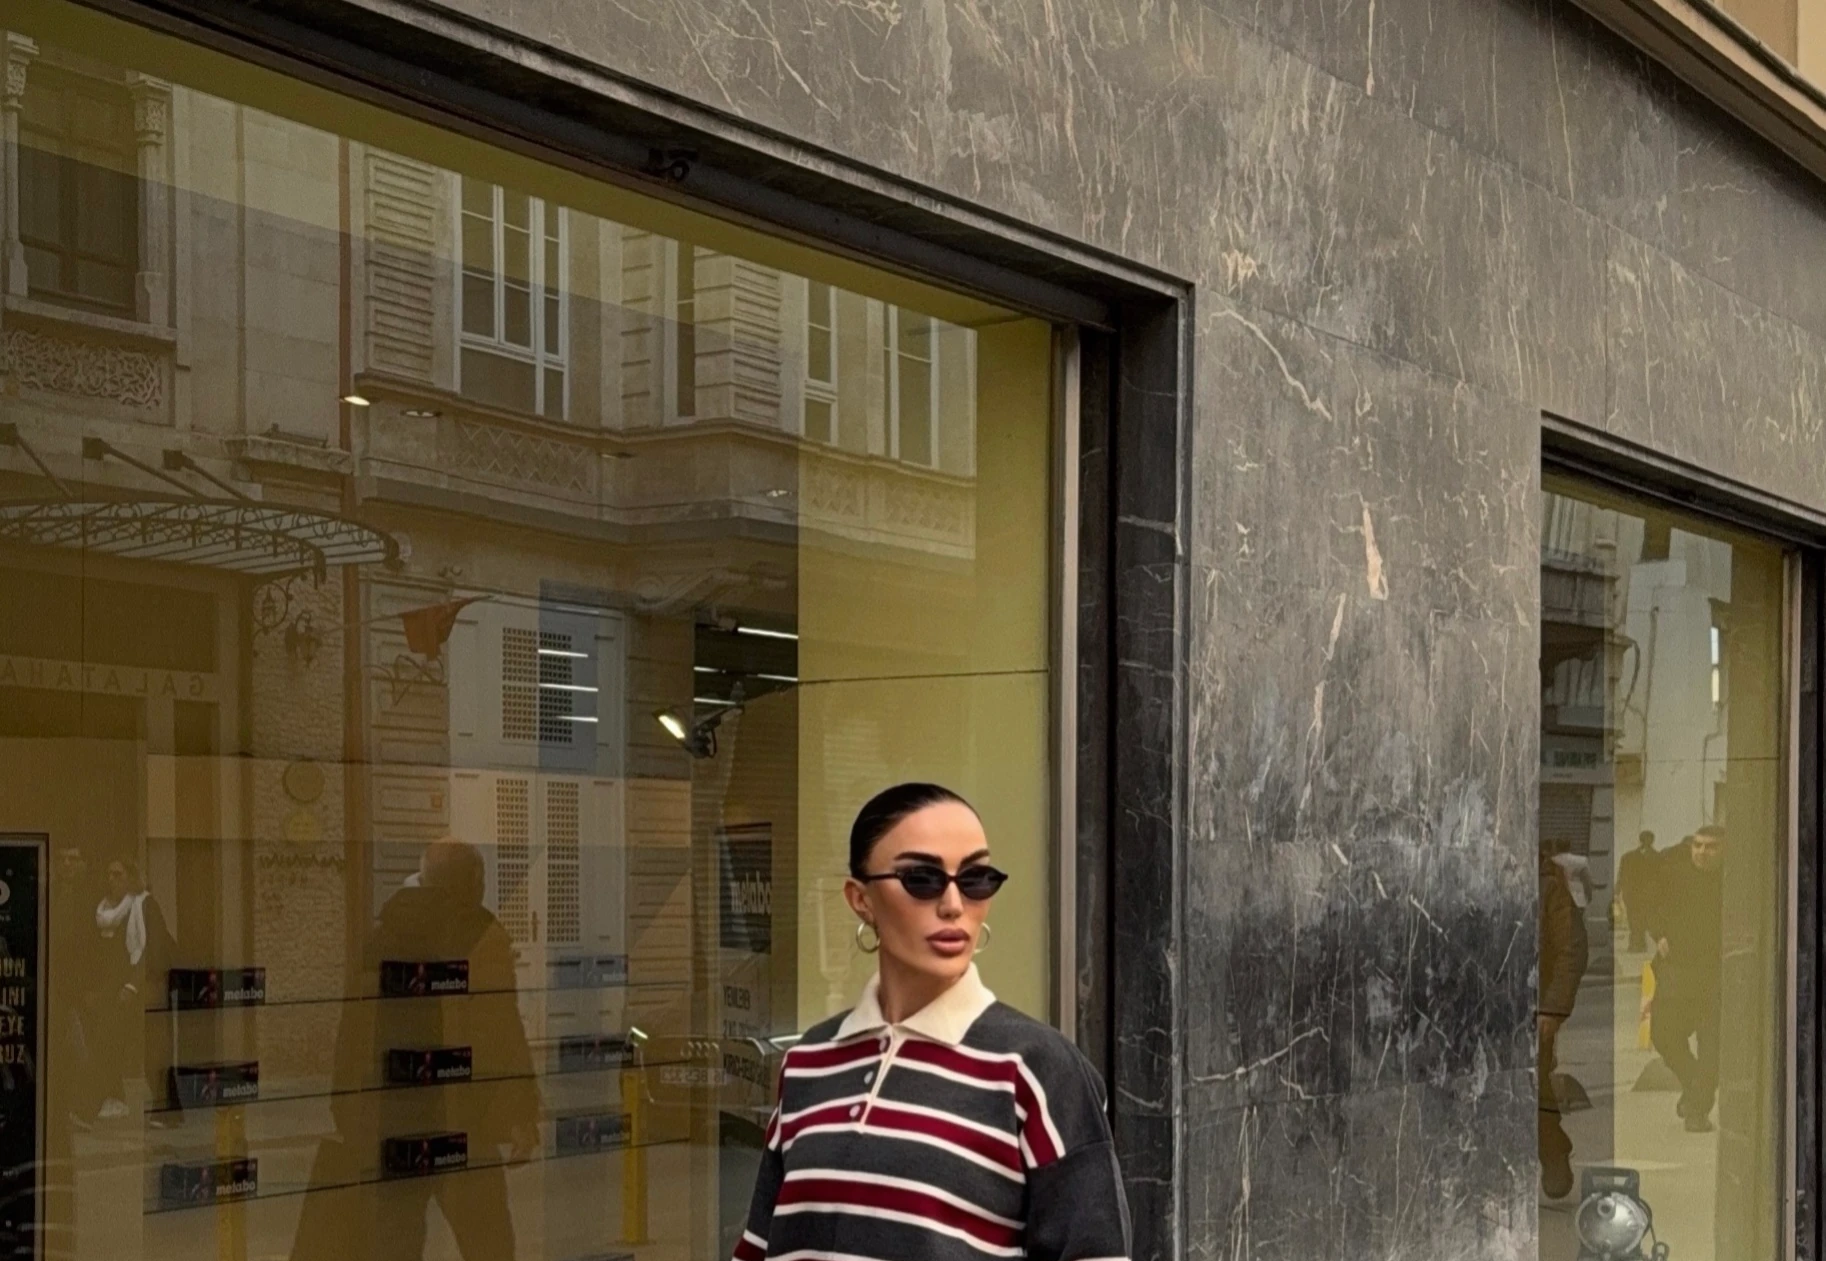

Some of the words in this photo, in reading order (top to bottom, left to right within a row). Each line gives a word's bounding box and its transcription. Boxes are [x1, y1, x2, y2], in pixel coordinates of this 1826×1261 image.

[0, 957, 25, 977] UN
[224, 987, 264, 1000] metabo
[223, 1082, 258, 1097] metabo
[216, 1180, 255, 1196] metabo
